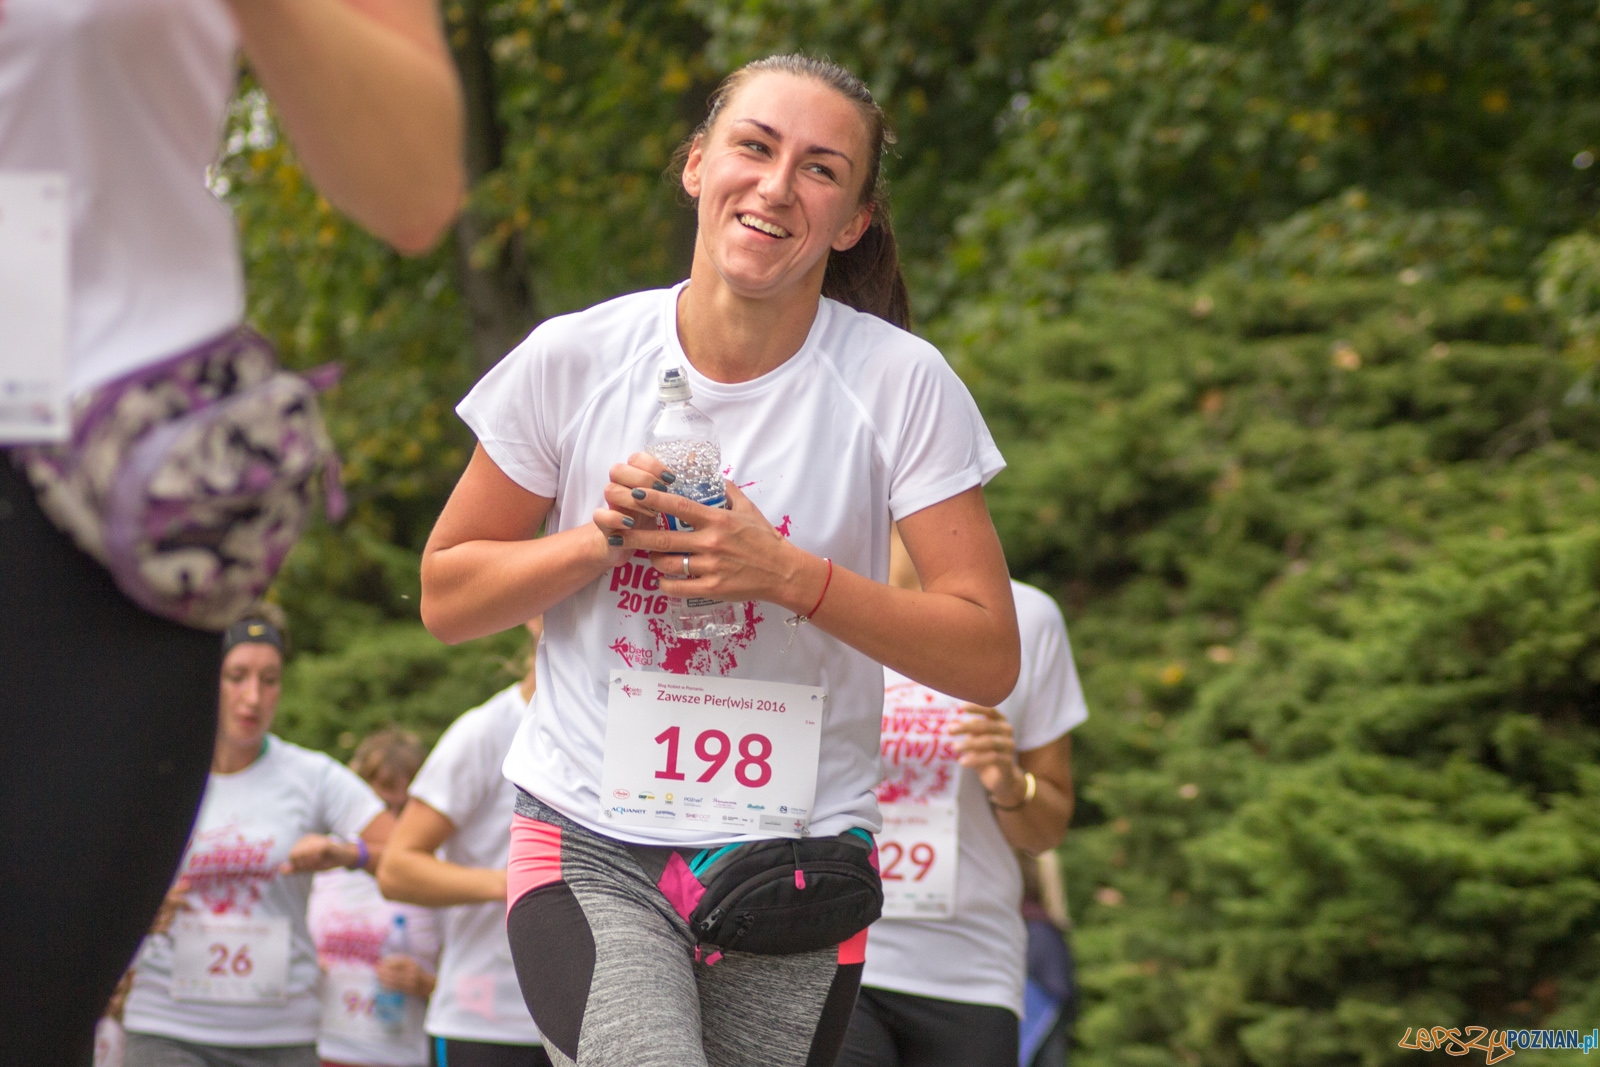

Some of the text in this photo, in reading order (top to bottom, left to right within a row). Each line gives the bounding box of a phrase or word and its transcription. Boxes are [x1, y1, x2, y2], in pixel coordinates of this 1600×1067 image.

[617, 591, 668, 615] 2016
[656, 689, 786, 713] Zawsze Pier(w)si 2016
[654, 725, 772, 788] 198
[208, 944, 253, 977] 26
